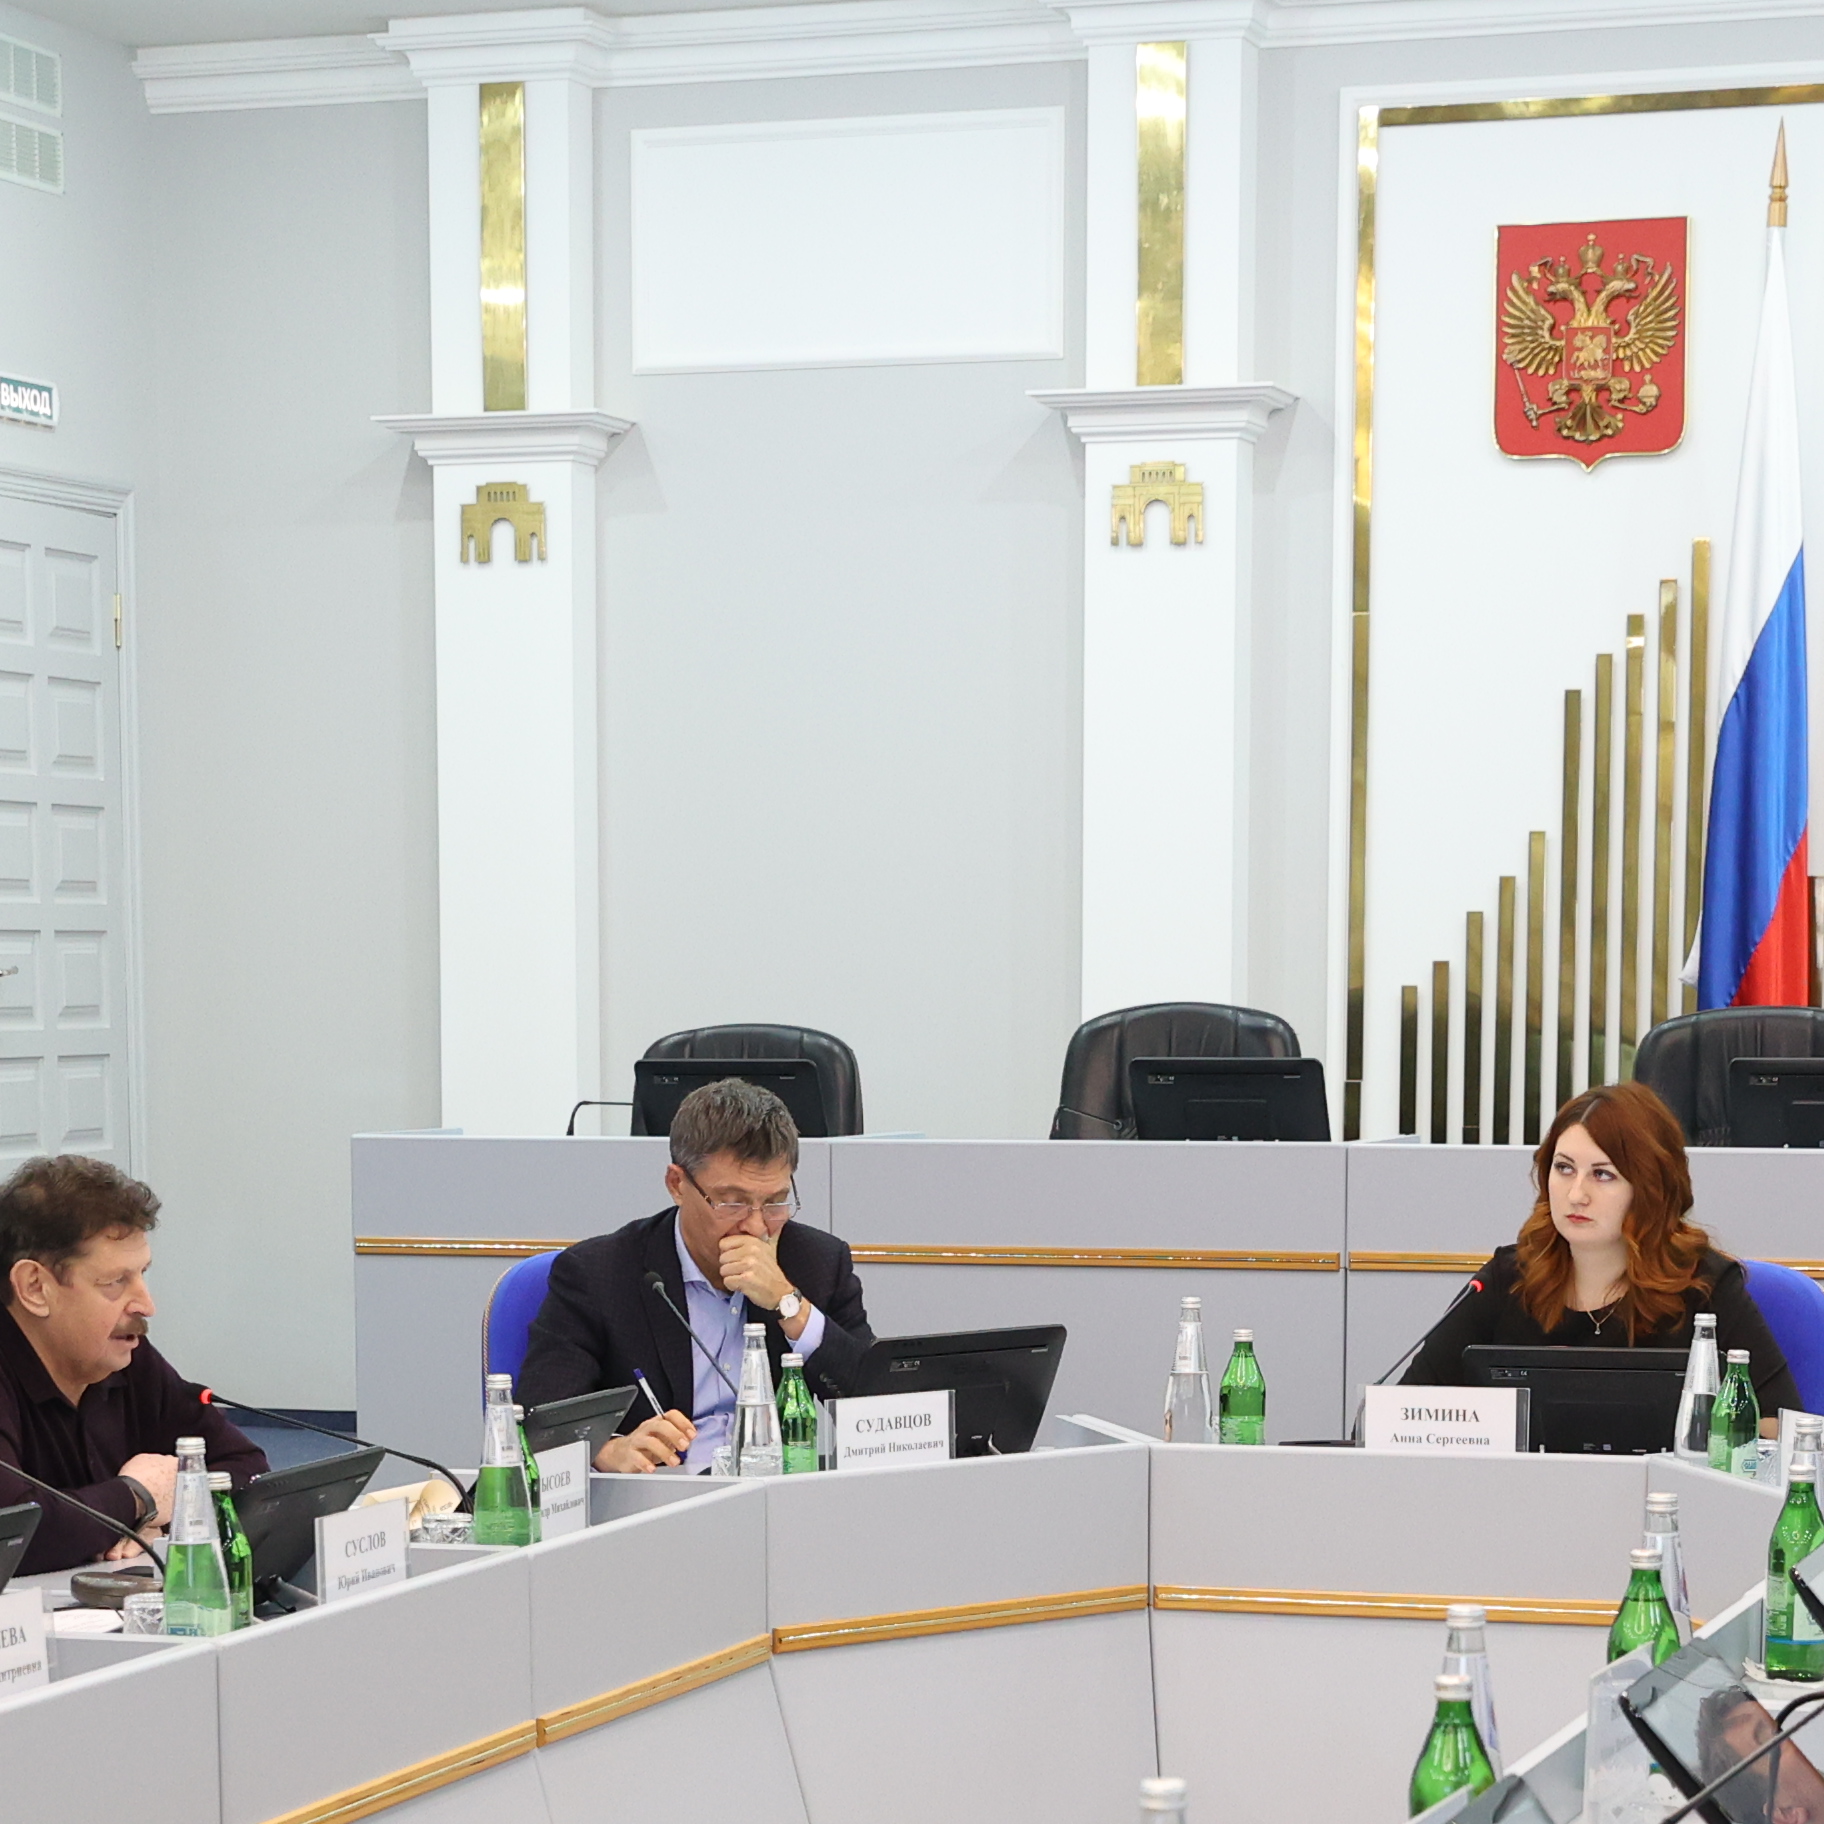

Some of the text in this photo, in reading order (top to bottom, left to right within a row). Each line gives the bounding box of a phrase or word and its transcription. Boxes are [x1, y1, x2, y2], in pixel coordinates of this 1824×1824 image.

[0, 382, 51, 416] ВЫХОД
[855, 1413, 932, 1433] СУДАВЦОВ
[1400, 1407, 1480, 1423] ЗИМИНА
[843, 1440, 944, 1458] Дмитрий Николаевич
[1390, 1433, 1490, 1447] Анна Сергеевна
[541, 1470, 571, 1493] ЫСОЕВ
[345, 1531, 386, 1558] СУСЛОВ
[338, 1563, 396, 1591] Юрий Иванович
